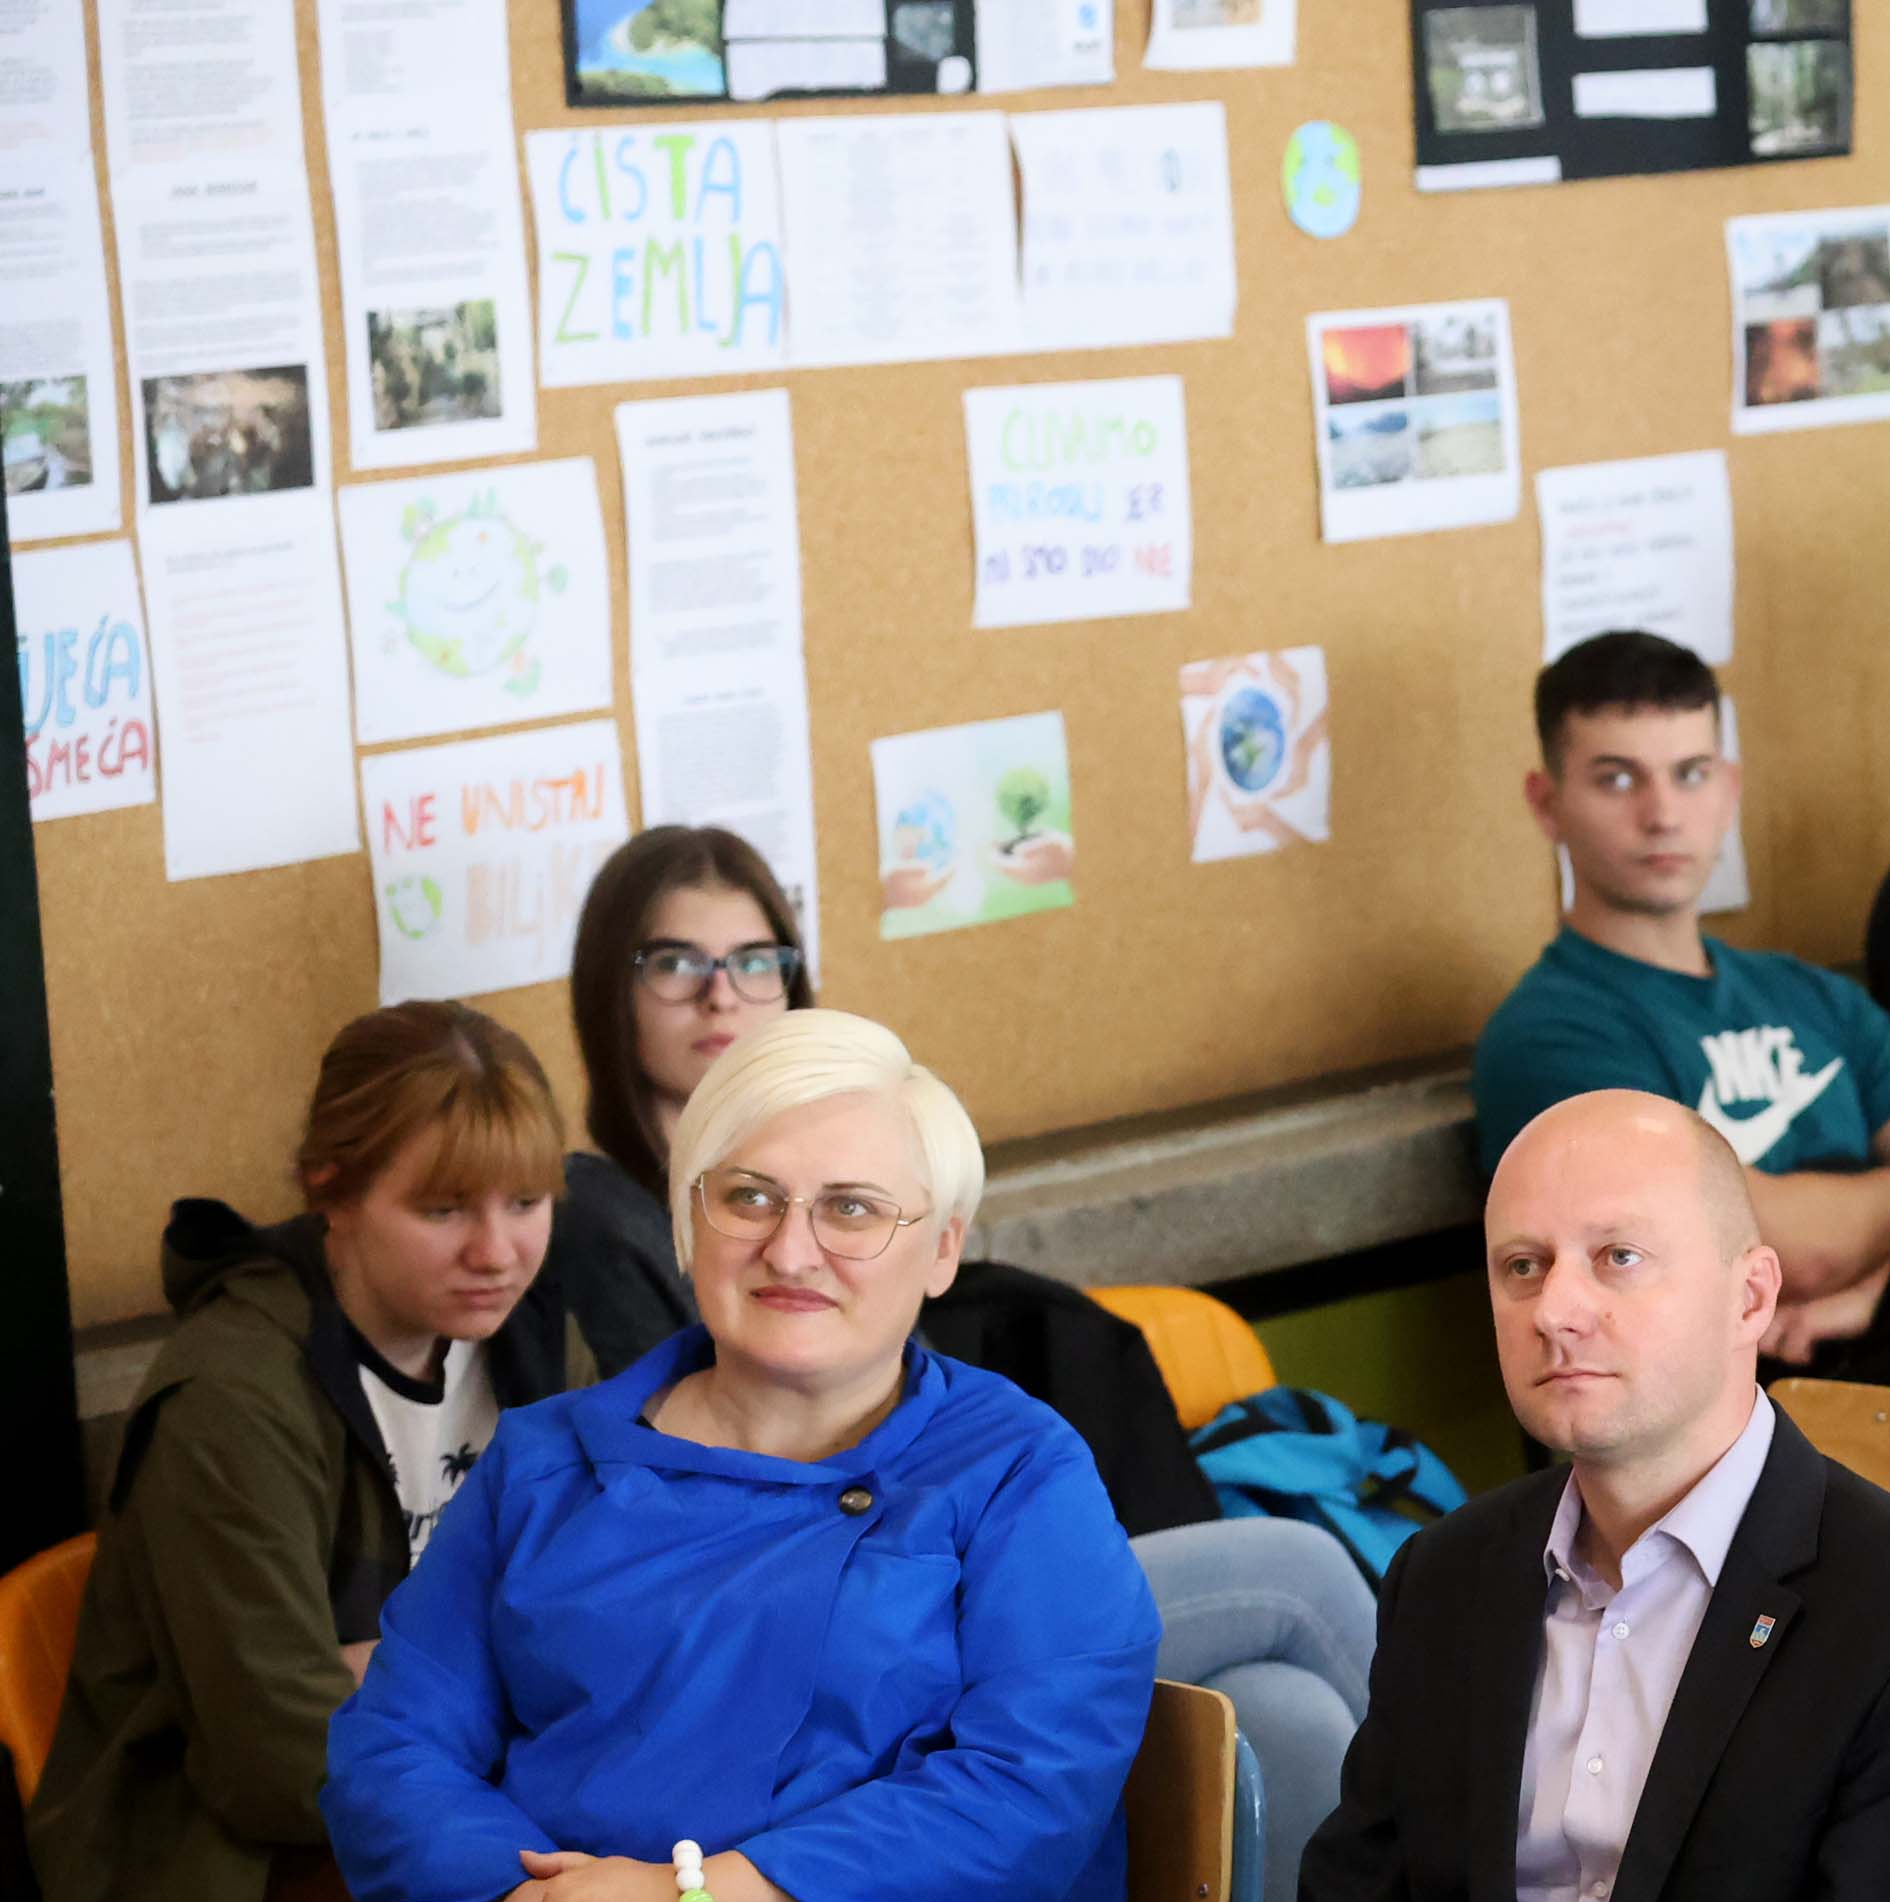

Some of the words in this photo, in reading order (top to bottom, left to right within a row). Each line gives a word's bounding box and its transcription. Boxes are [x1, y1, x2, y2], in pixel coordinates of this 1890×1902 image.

[552, 233, 785, 348] ZEMLJA
[382, 791, 438, 856] NE
[1698, 1024, 1812, 1105] NIKE
